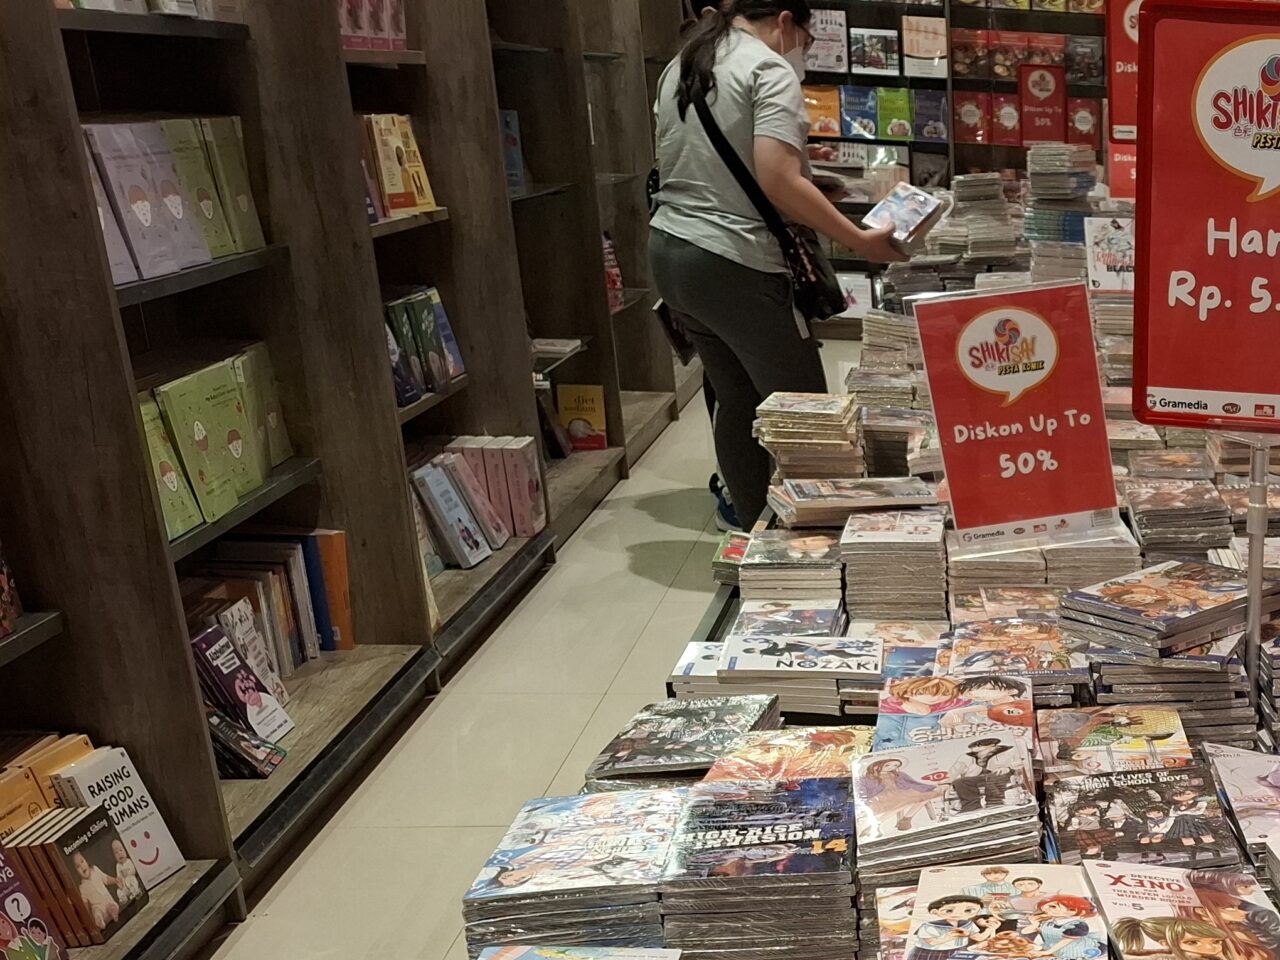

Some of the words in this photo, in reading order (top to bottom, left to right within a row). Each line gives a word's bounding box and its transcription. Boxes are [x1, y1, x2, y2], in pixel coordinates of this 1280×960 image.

[1168, 270, 1232, 321] Rp.
[998, 364, 1020, 375] PESTA
[1022, 360, 1045, 372] KOMIK
[1159, 398, 1208, 411] Gramedia
[953, 422, 1023, 445] Diskon
[1029, 413, 1058, 437] Up
[1064, 409, 1091, 427] To
[999, 449, 1059, 479] 50%
[973, 530, 1005, 541] Gramedia
[88, 766, 130, 799] RAISING
[1113, 777, 1157, 787] SCHOOL
[1159, 774, 1189, 783] BOYS
[102, 785, 134, 812] GOOD
[110, 795, 150, 827] UMANS
[679, 823, 802, 842] HIGH-RISE
[693, 829, 822, 850] INVASION
[64, 832, 88, 856] Becoming
[810, 838, 848, 855] 14
[1131, 902, 1145, 911] 5
